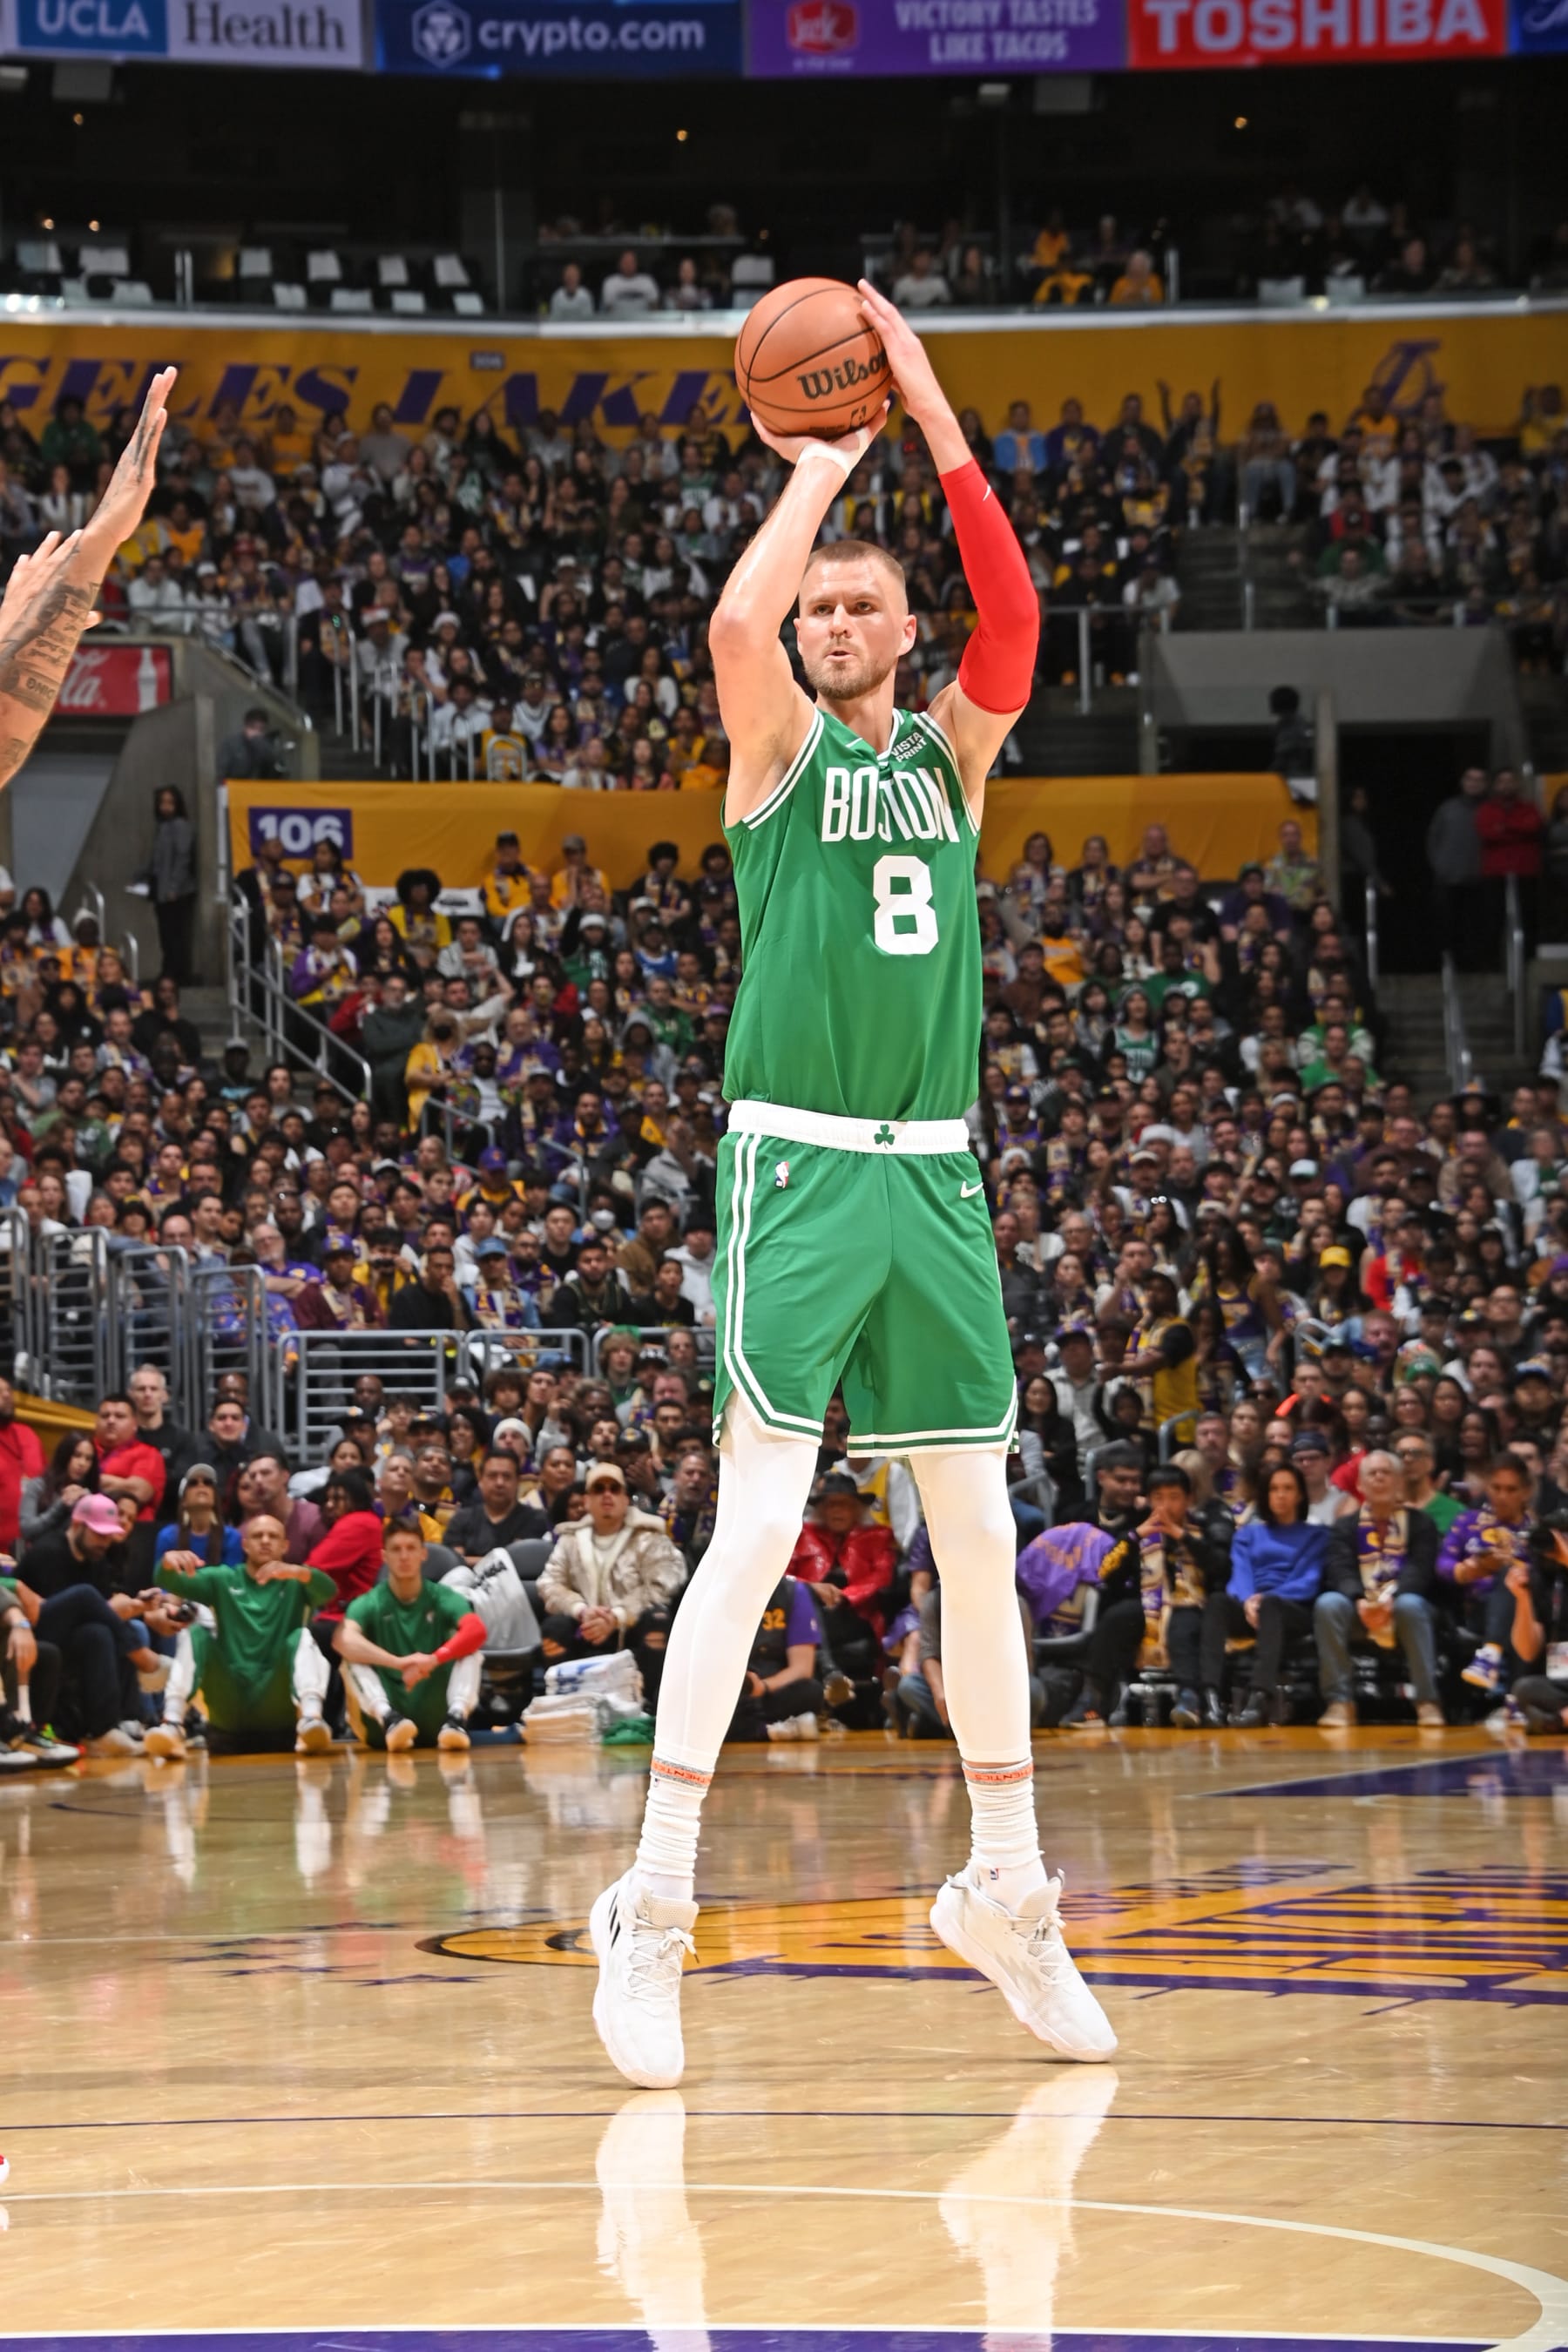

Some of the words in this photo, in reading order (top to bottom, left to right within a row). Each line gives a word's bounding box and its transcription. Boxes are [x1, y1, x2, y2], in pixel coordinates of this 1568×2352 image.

[36, 0, 151, 39] UCLA
[185, 2, 347, 51] Health
[478, 15, 706, 57] crypto.com
[895, 0, 1002, 30] VICTORY
[1008, 0, 1099, 27] TASTES
[1144, 0, 1489, 53] TOSHIBA
[929, 32, 985, 64] LIKE
[993, 30, 1069, 62] TACOS
[890, 732, 923, 757] VISTA
[896, 738, 927, 763] PRINT
[821, 767, 960, 842] BOSTON
[873, 855, 939, 955] 8
